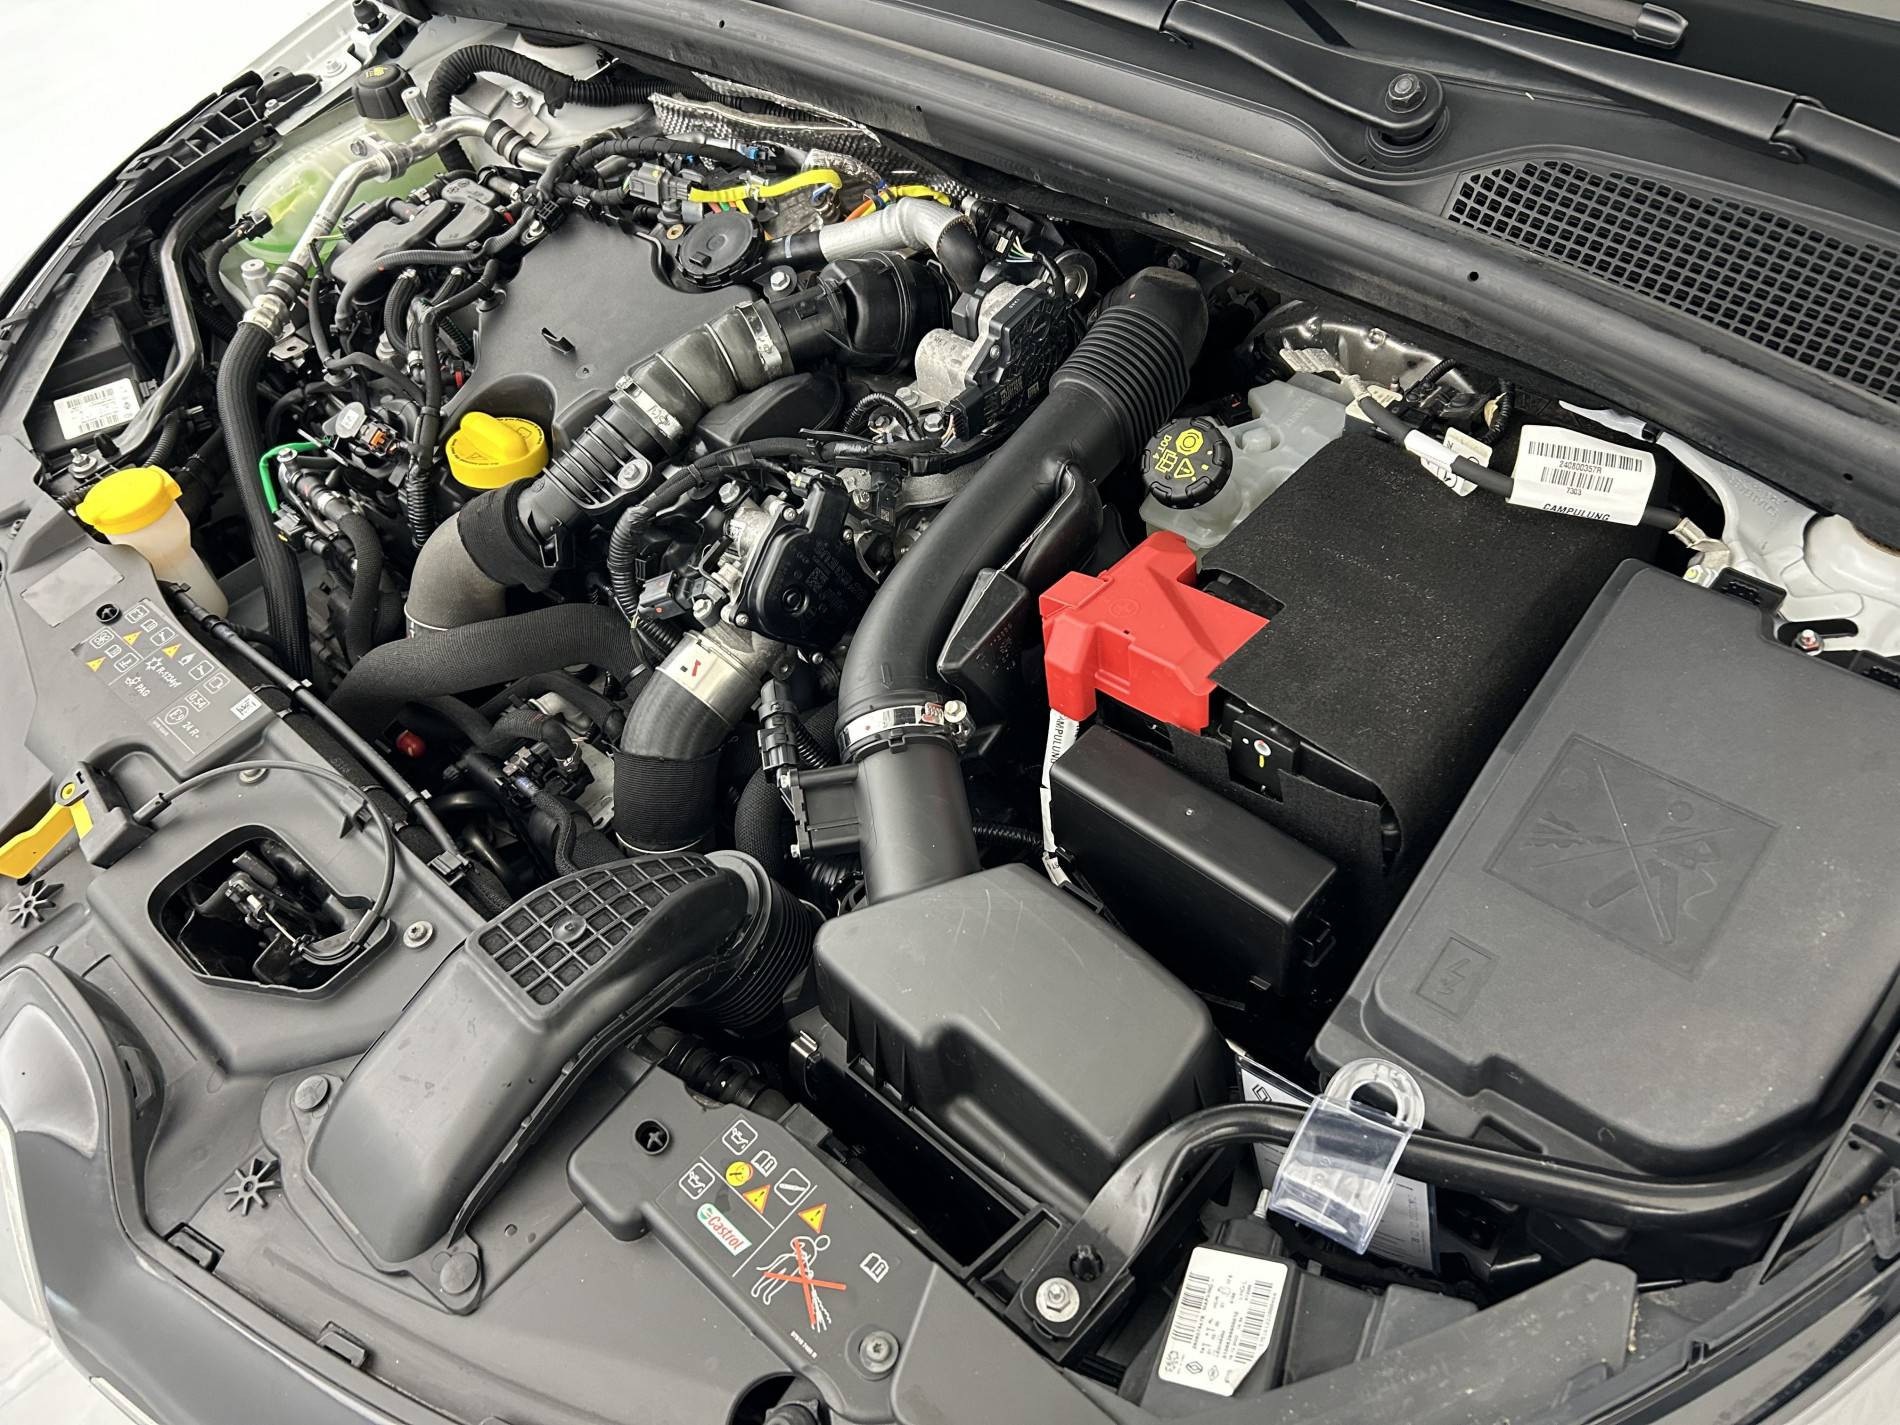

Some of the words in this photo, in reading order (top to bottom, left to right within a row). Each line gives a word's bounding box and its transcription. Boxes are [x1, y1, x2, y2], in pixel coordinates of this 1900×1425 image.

[1157, 434, 1172, 453] DOT
[1152, 452, 1160, 460] 4
[1542, 503, 1611, 521] CAMPULUNG
[135, 682, 150, 697] PAG
[707, 1213, 745, 1251] Castrol
